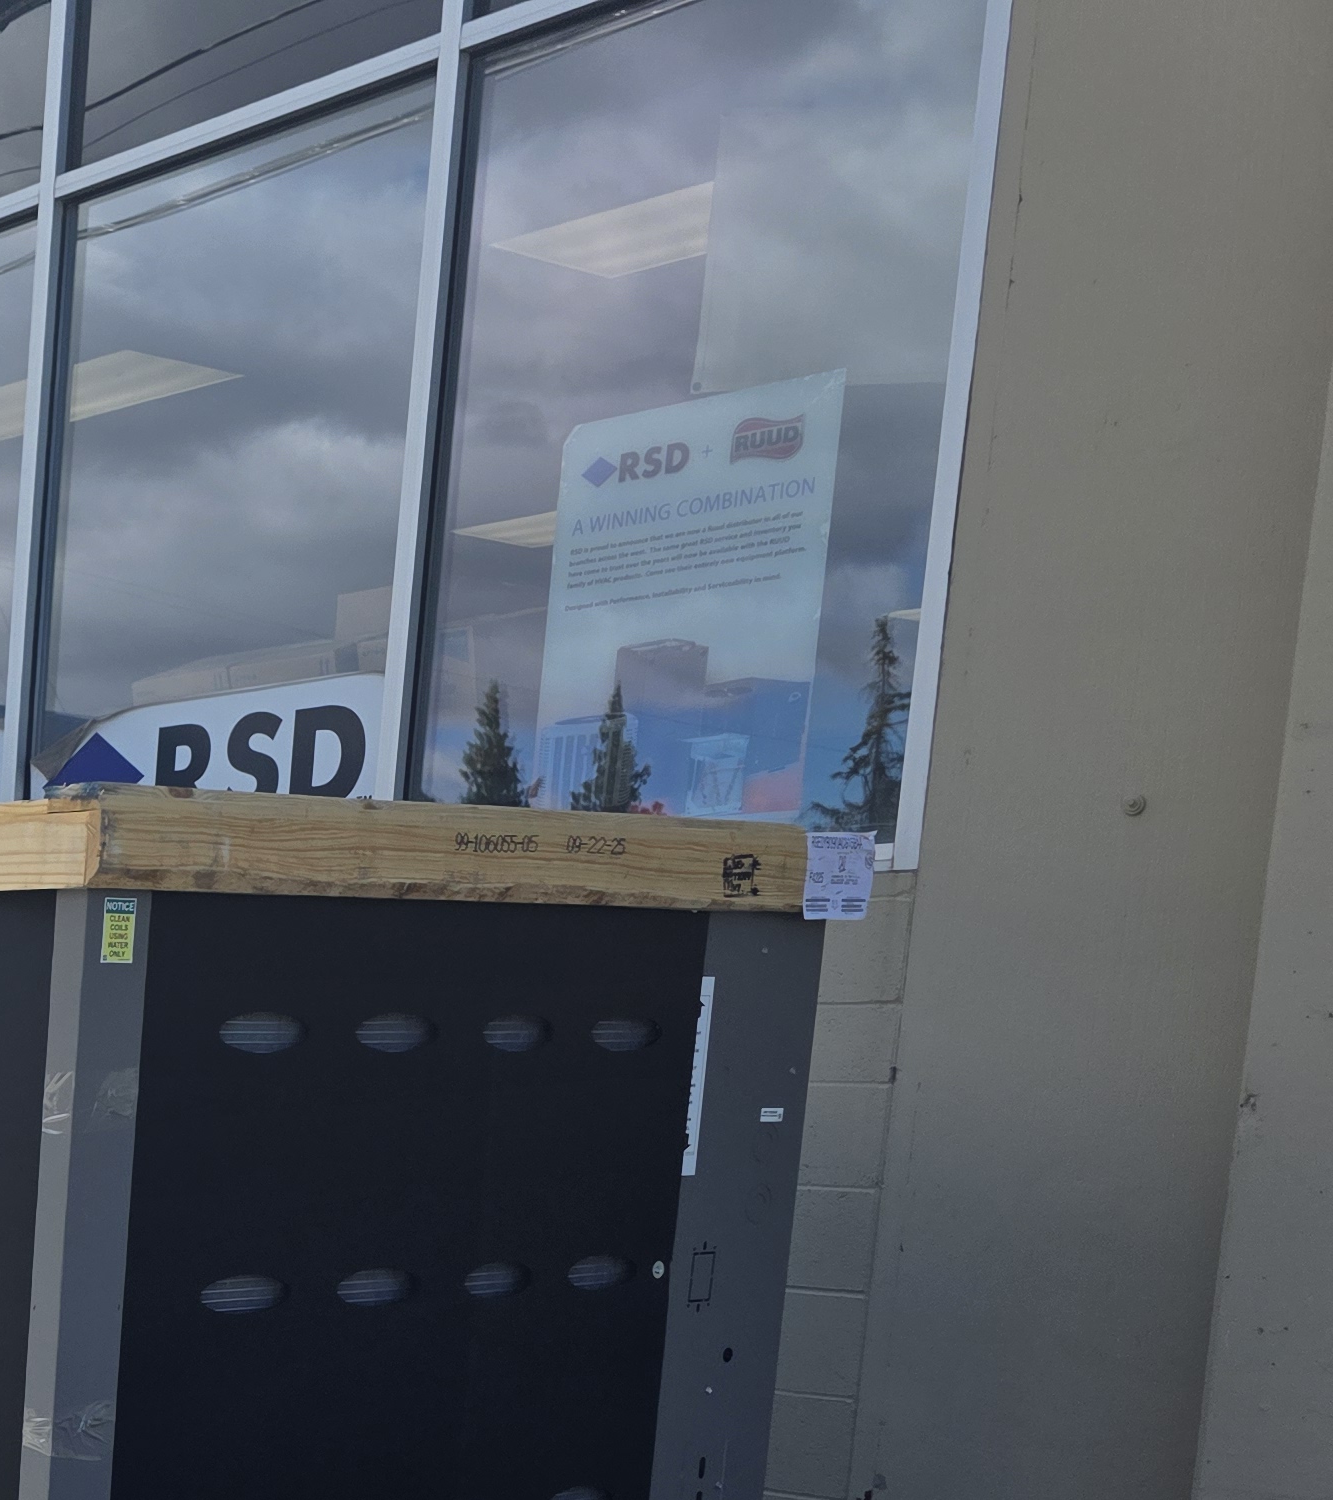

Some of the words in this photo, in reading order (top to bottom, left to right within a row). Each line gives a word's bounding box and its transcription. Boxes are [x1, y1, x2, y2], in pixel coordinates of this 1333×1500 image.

[617, 442, 690, 483] RSD
[734, 425, 800, 453] RUUD
[572, 519, 583, 536] A
[589, 503, 671, 532] WINNING
[677, 476, 815, 518] COMBINATION
[569, 557, 596, 567] branches
[598, 554, 617, 563] across
[681, 540, 698, 550] great
[714, 533, 738, 542] service
[739, 530, 752, 539] and
[754, 526, 787, 536] inventory
[788, 524, 801, 532] you
[590, 543, 609, 554] proud
[618, 537, 648, 548] announce
[650, 534, 664, 542] that
[726, 518, 762, 529] distributor
[772, 513, 781, 521] all
[782, 511, 790, 519] of
[567, 579, 586, 589] family
[587, 577, 594, 586] of
[594, 576, 612, 585] HVAC
[645, 568, 663, 577] Come
[677, 564, 693, 572] their
[694, 557, 719, 569] entirely
[736, 550, 773, 562] equipment
[568, 570, 582, 578] have
[584, 568, 600, 576] come
[609, 564, 624, 572] trust
[640, 559, 651, 567] the
[652, 557, 669, 566] years
[671, 553, 683, 562] will
[699, 549, 707, 557] be
[740, 542, 755, 550] with
[757, 539, 768, 547] the
[769, 536, 790, 545] RUUD
[565, 602, 593, 612] Designed
[594, 599, 608, 607] with
[652, 586, 693, 598] Installability
[694, 584, 707, 592] and
[708, 578, 753, 590] Serviceability
[156, 704, 366, 798] RSD
[566, 834, 626, 855] 09-22-25
[106, 902, 134, 911] NOTICE
